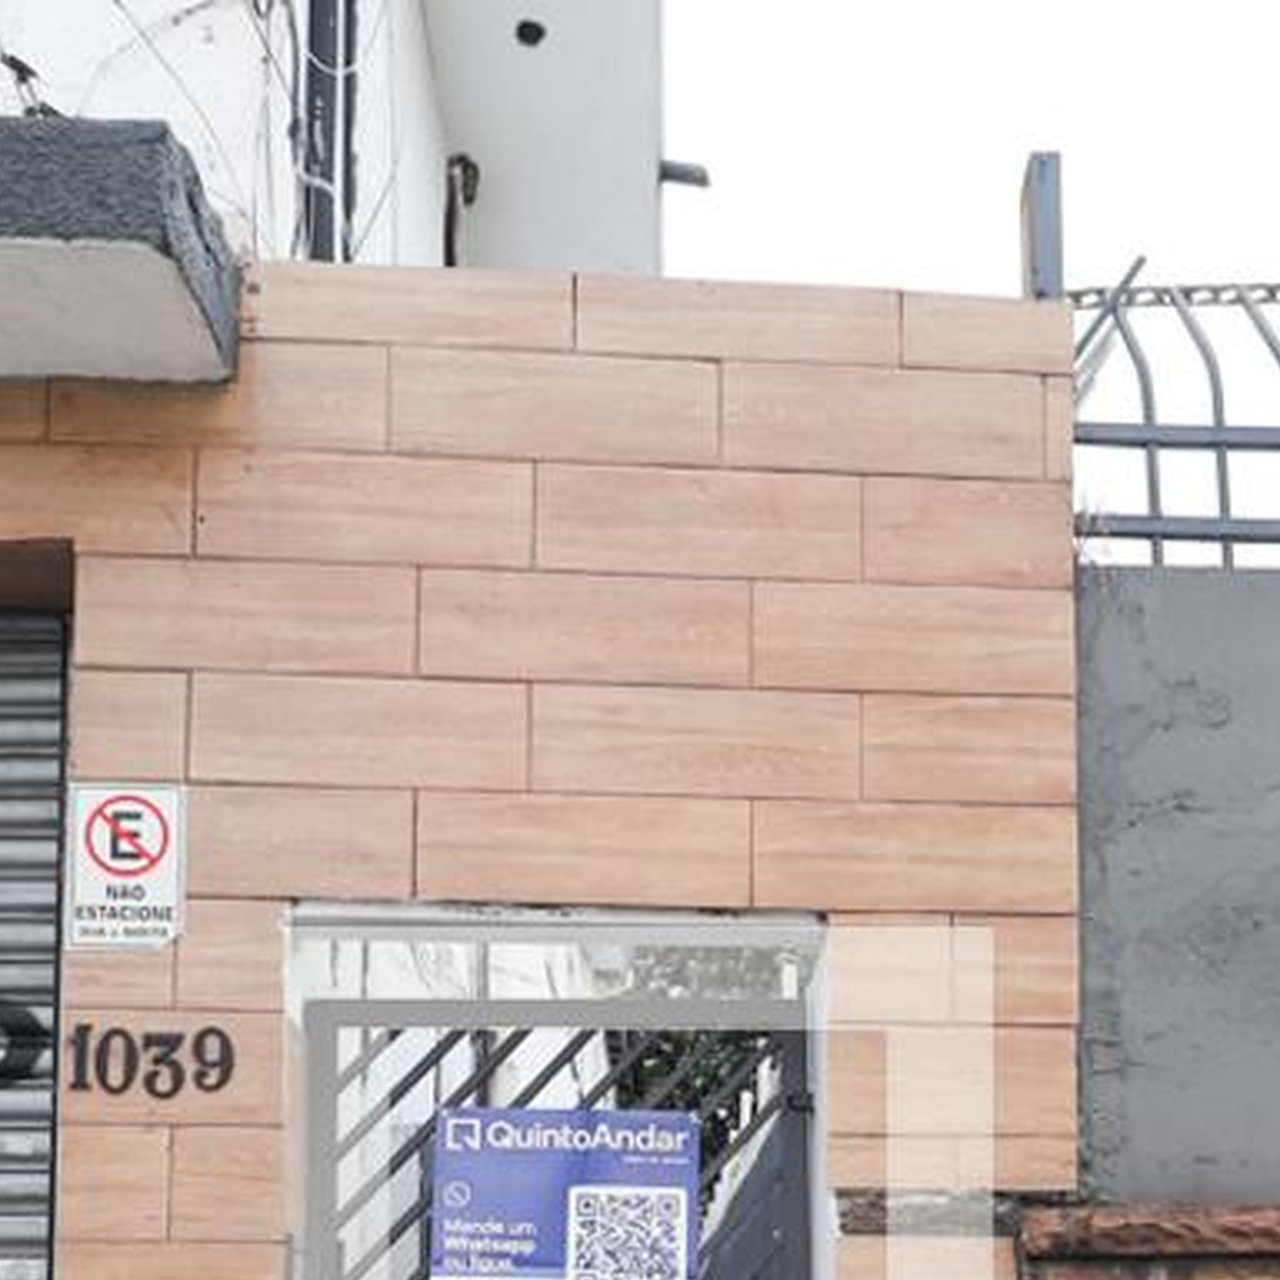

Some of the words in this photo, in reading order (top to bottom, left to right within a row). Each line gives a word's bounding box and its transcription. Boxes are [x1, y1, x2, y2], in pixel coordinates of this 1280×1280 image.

[74, 905, 173, 922] ESTACIONE
[68, 1023, 235, 1101] 1039
[486, 1120, 690, 1151] QuintoAndar
[508, 1221, 538, 1236] um
